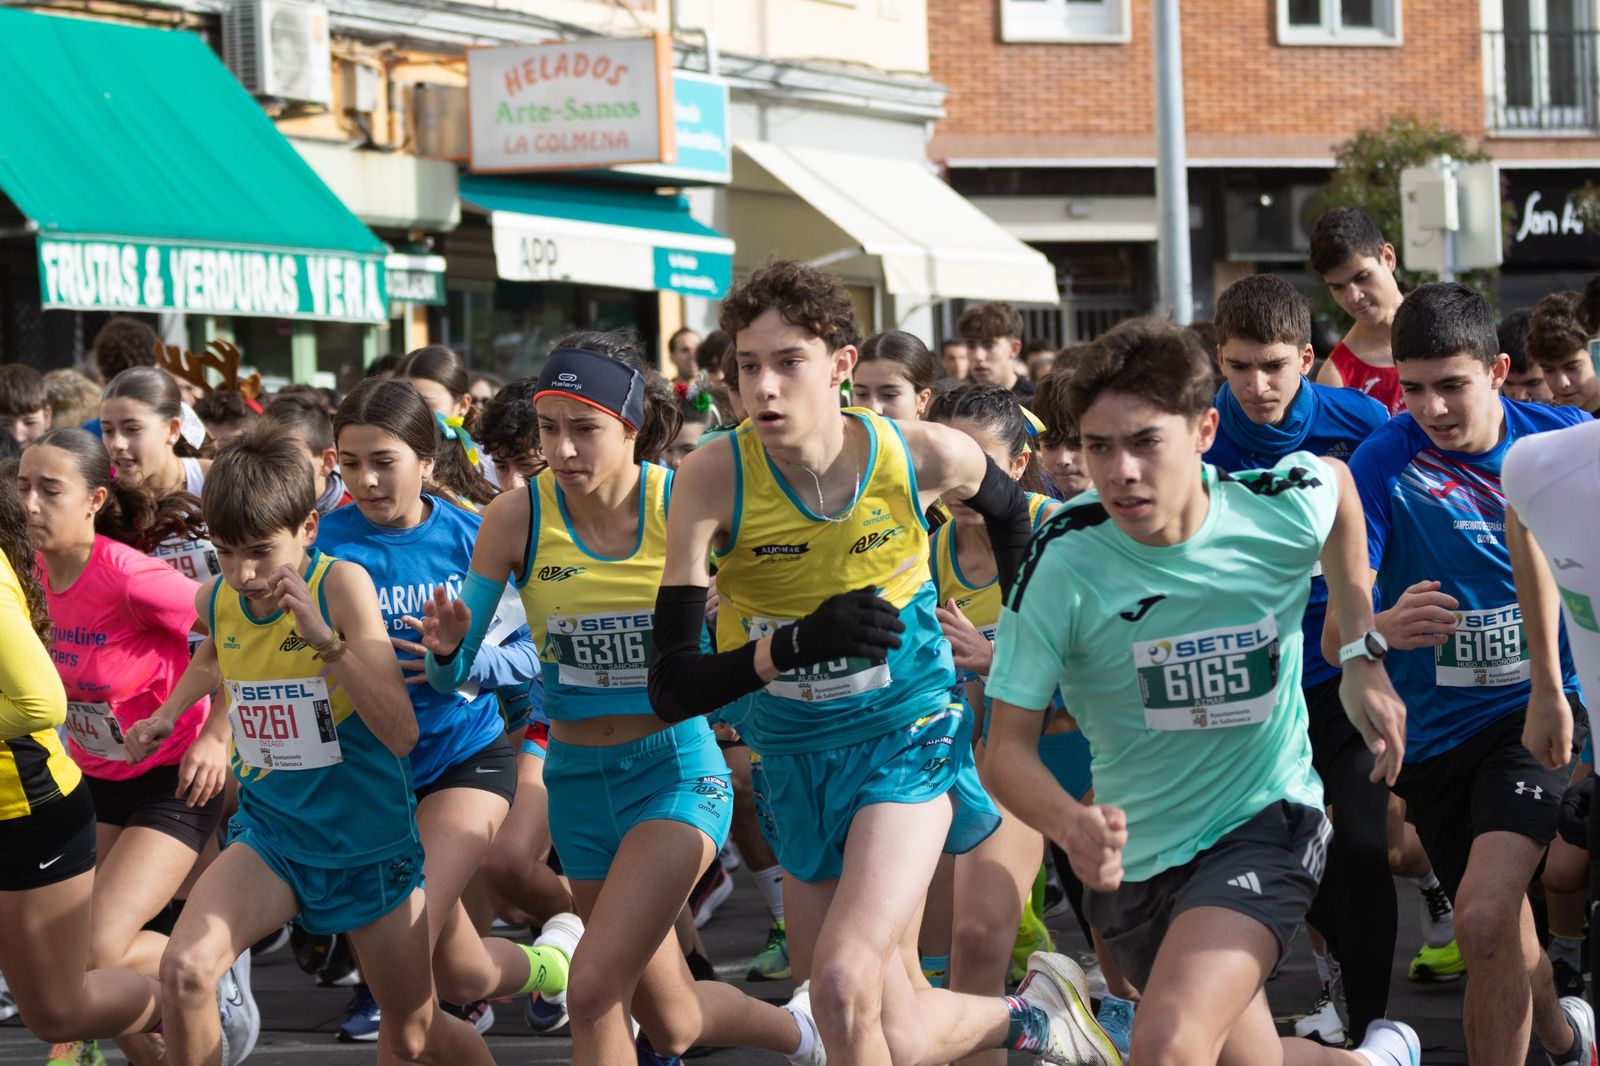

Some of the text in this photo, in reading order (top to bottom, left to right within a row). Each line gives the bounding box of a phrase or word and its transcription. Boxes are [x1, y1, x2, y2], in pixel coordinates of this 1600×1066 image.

[504, 53, 629, 96] HELADOS
[495, 98, 641, 124] Arte-Sanos
[503, 130, 630, 154] LA COLMENA
[41, 242, 139, 306] FRUTAS
[143, 245, 165, 307] &
[169, 247, 299, 316] VERDURAS
[305, 254, 386, 321] VERA
[571, 631, 646, 665] 6316
[1175, 629, 1269, 658] SETEL
[1456, 625, 1521, 662] 6169
[577, 662, 646, 671] MARTA SANCHEZ
[797, 673, 831, 682] ALEXIS
[1163, 653, 1251, 701] 6165
[241, 684, 314, 701] SETEL
[237, 704, 300, 740] 6261
